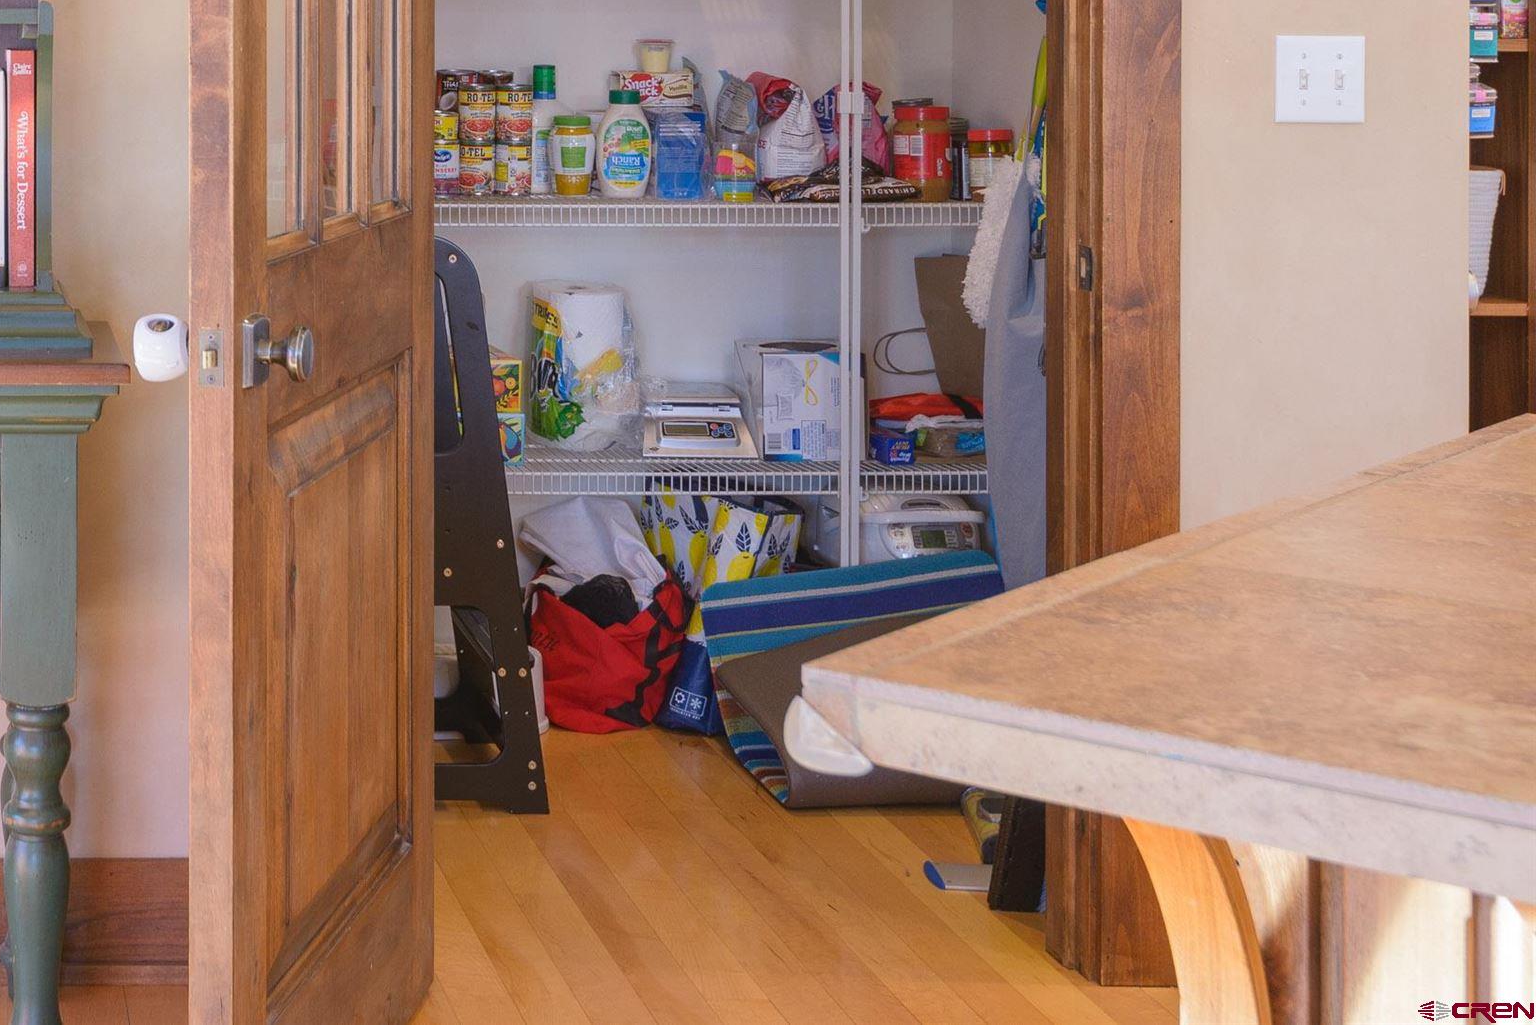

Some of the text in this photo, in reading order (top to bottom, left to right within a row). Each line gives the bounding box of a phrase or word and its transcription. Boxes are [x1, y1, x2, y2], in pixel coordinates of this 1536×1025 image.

[624, 77, 659, 90] Snack
[639, 87, 659, 96] ack
[507, 92, 532, 102] ROTE
[460, 147, 486, 157] OTEL
[612, 156, 640, 166] Ranch
[16, 111, 29, 230] What's for Dessert
[860, 186, 916, 196] GHIRARDELL
